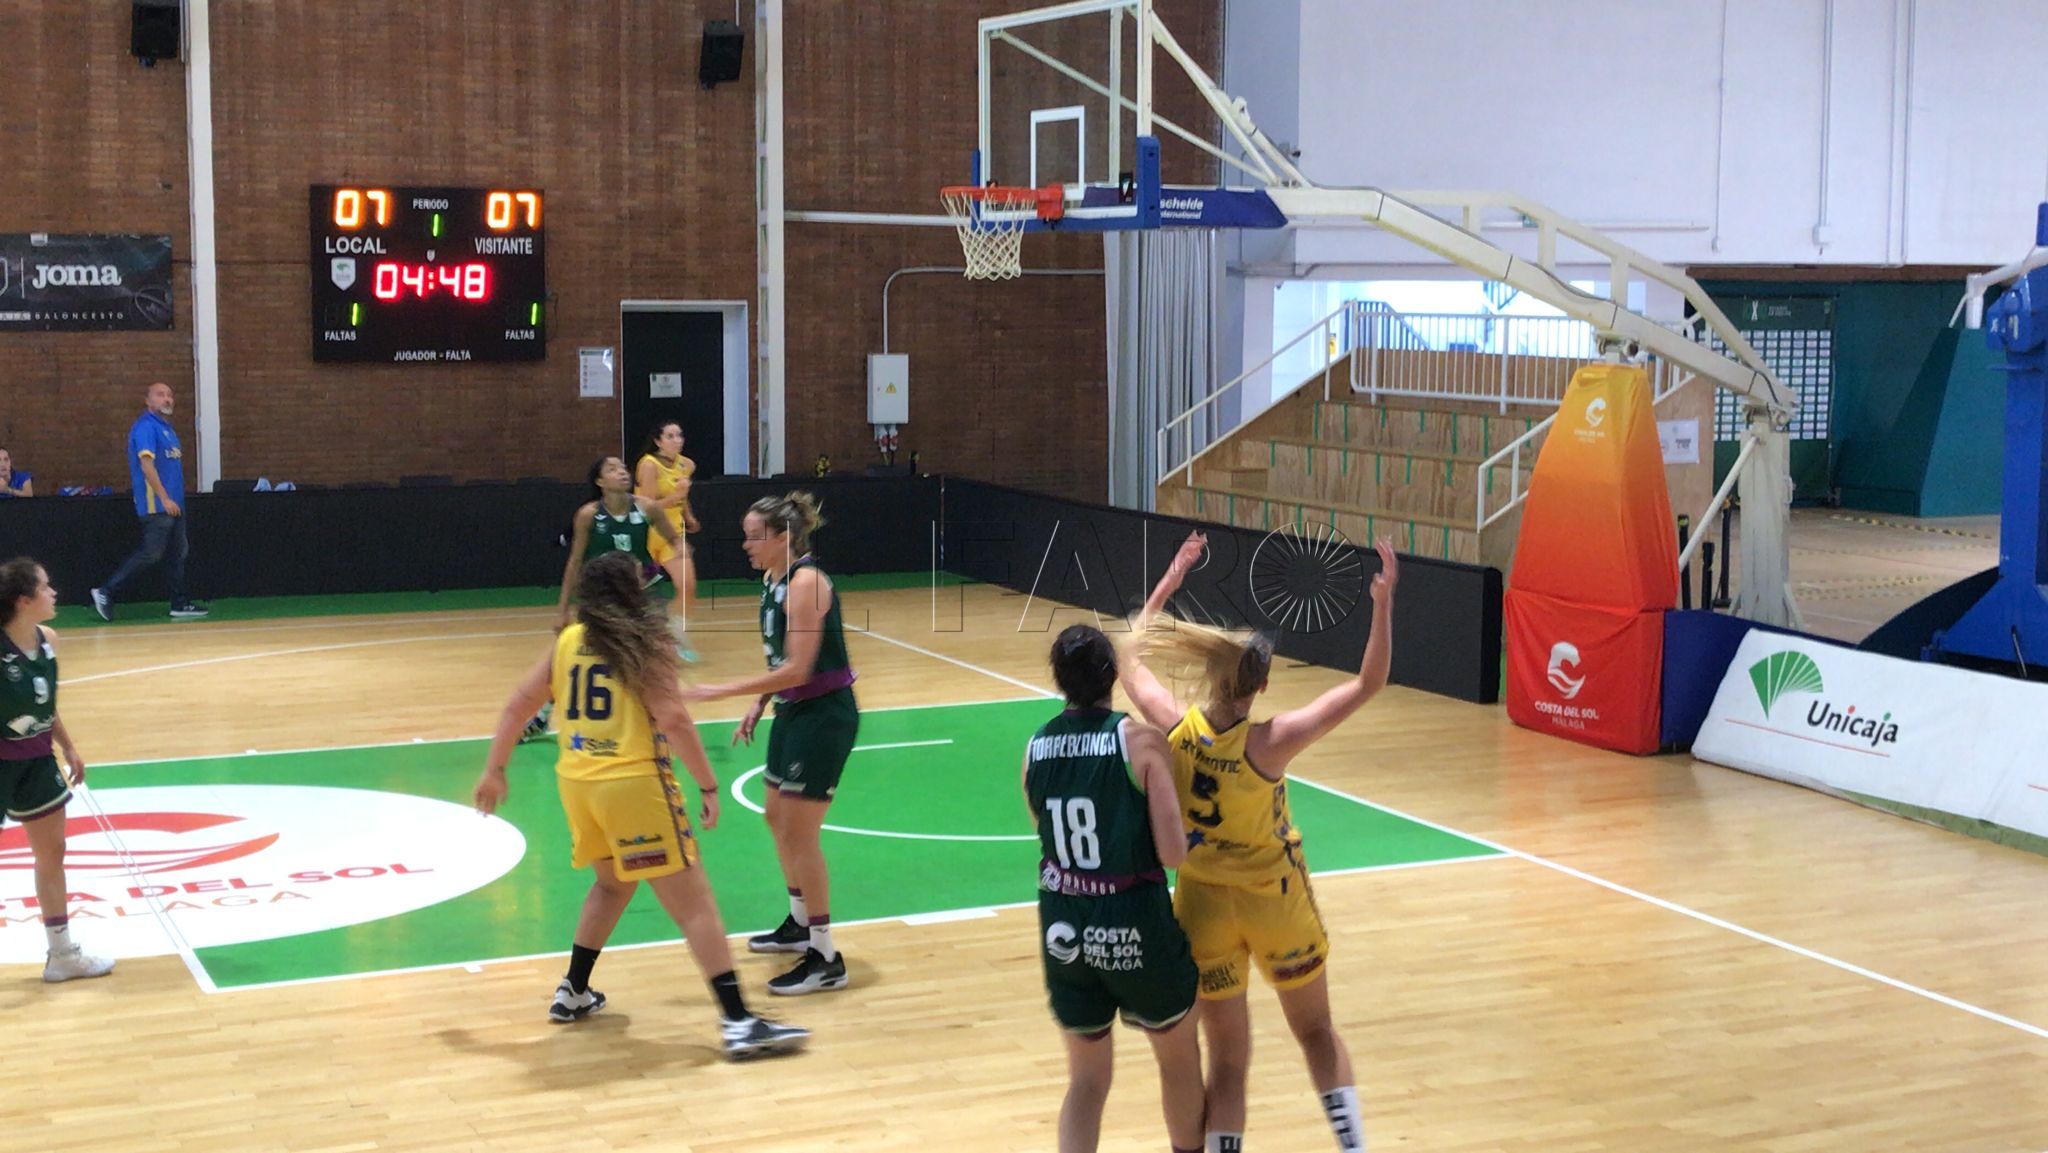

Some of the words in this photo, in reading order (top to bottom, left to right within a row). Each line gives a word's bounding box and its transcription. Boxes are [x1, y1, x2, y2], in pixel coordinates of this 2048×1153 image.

[335, 190, 386, 226] 07
[413, 198, 449, 210] PERIODO
[487, 192, 536, 228] 07
[432, 213, 440, 237] 1
[325, 236, 387, 255] LOCAL
[475, 237, 533, 255] VISITANTE
[375, 264, 486, 299] 04:48
[35, 311, 124, 321] BALONCESTO
[324, 331, 357, 342] FALTAS
[505, 330, 536, 341] FALTAS
[394, 351, 437, 362] JUGADOR
[446, 351, 472, 362] FALTA
[567, 663, 612, 721] 16
[1534, 700, 1563, 715] COSTA
[1563, 705, 1580, 718] DEL
[1581, 708, 1599, 720] SOL
[1807, 699, 1899, 748] Unicaja
[1031, 731, 1117, 763] TORREBLANCA
[1046, 796, 1101, 870] 18
[127, 877, 272, 899] DEL
[289, 862, 434, 883] SOL
[1083, 925, 1142, 944] COSTA
[1083, 942, 1110, 958] DEL
[1112, 943, 1143, 959] SOL
